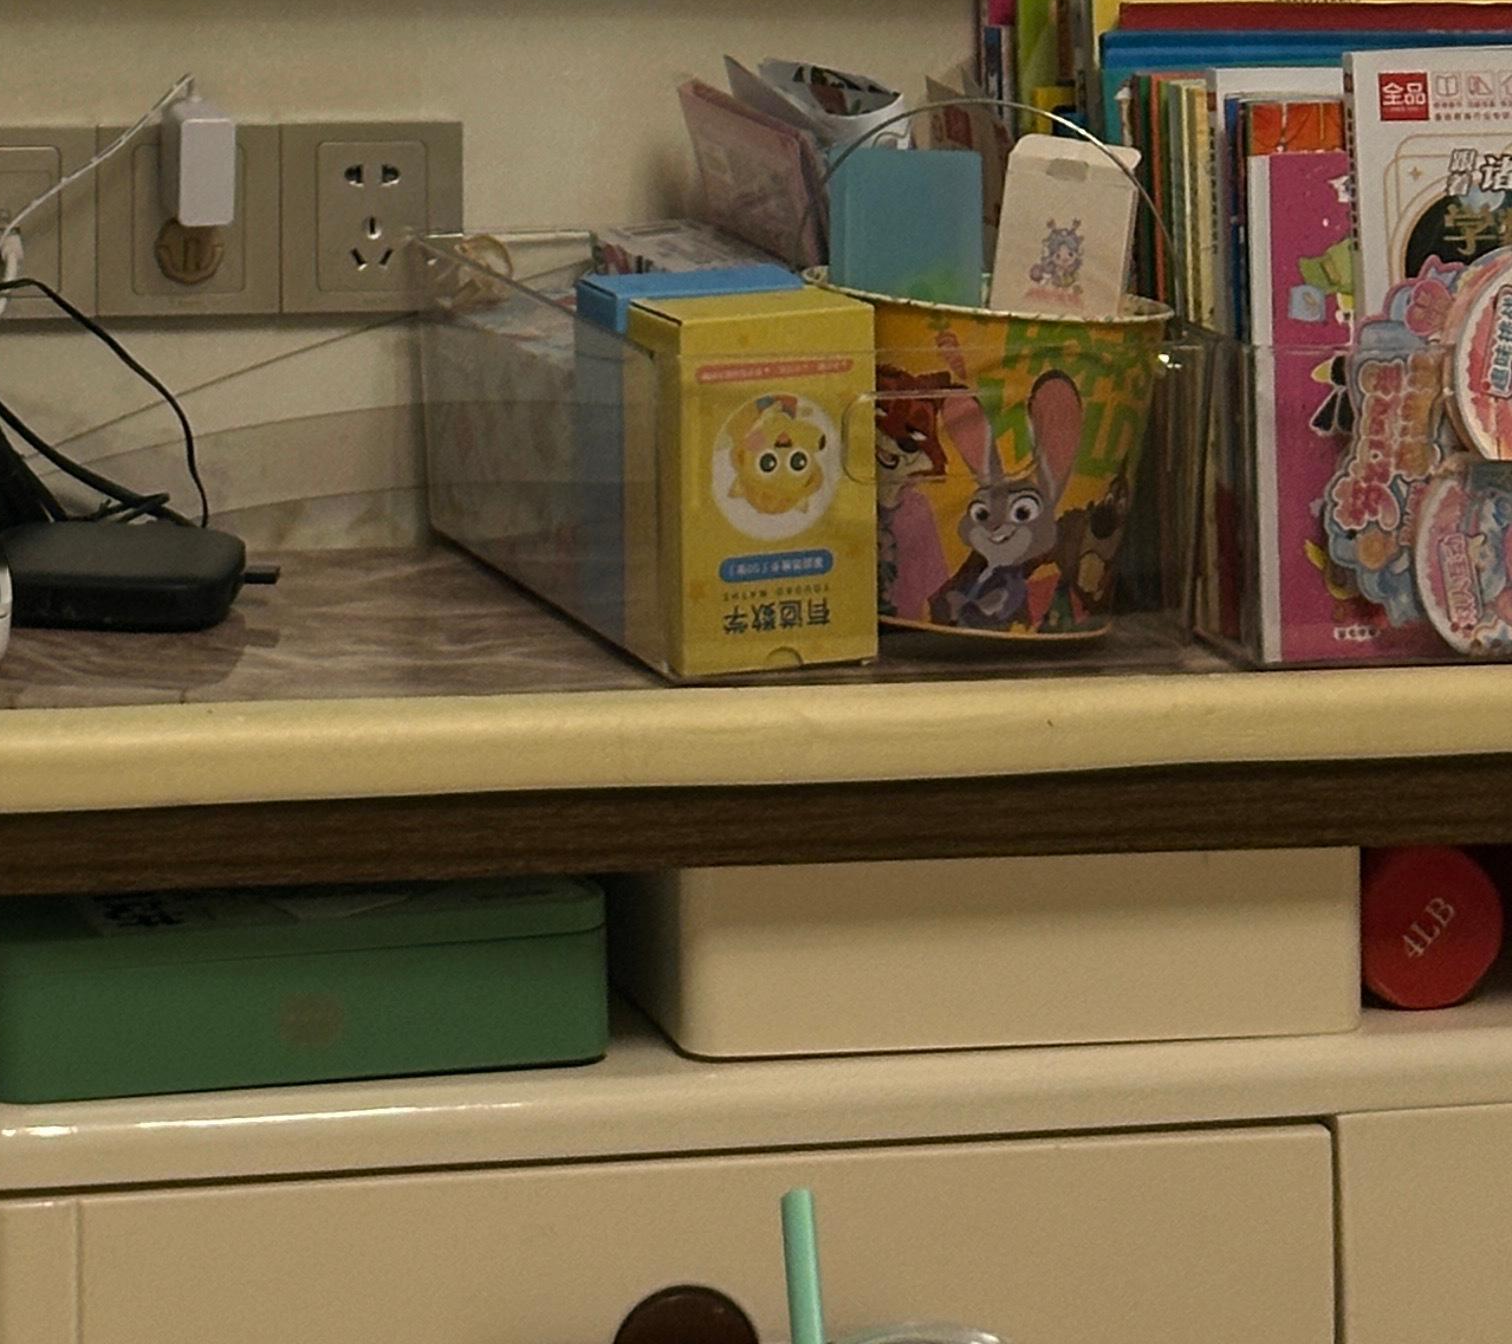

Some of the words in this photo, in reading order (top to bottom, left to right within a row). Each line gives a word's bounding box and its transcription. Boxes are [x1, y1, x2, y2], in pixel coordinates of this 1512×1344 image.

[1382, 82, 1426, 106] 全品
[723, 597, 831, 635] 有道数学
[1401, 896, 1456, 959] 4LB
